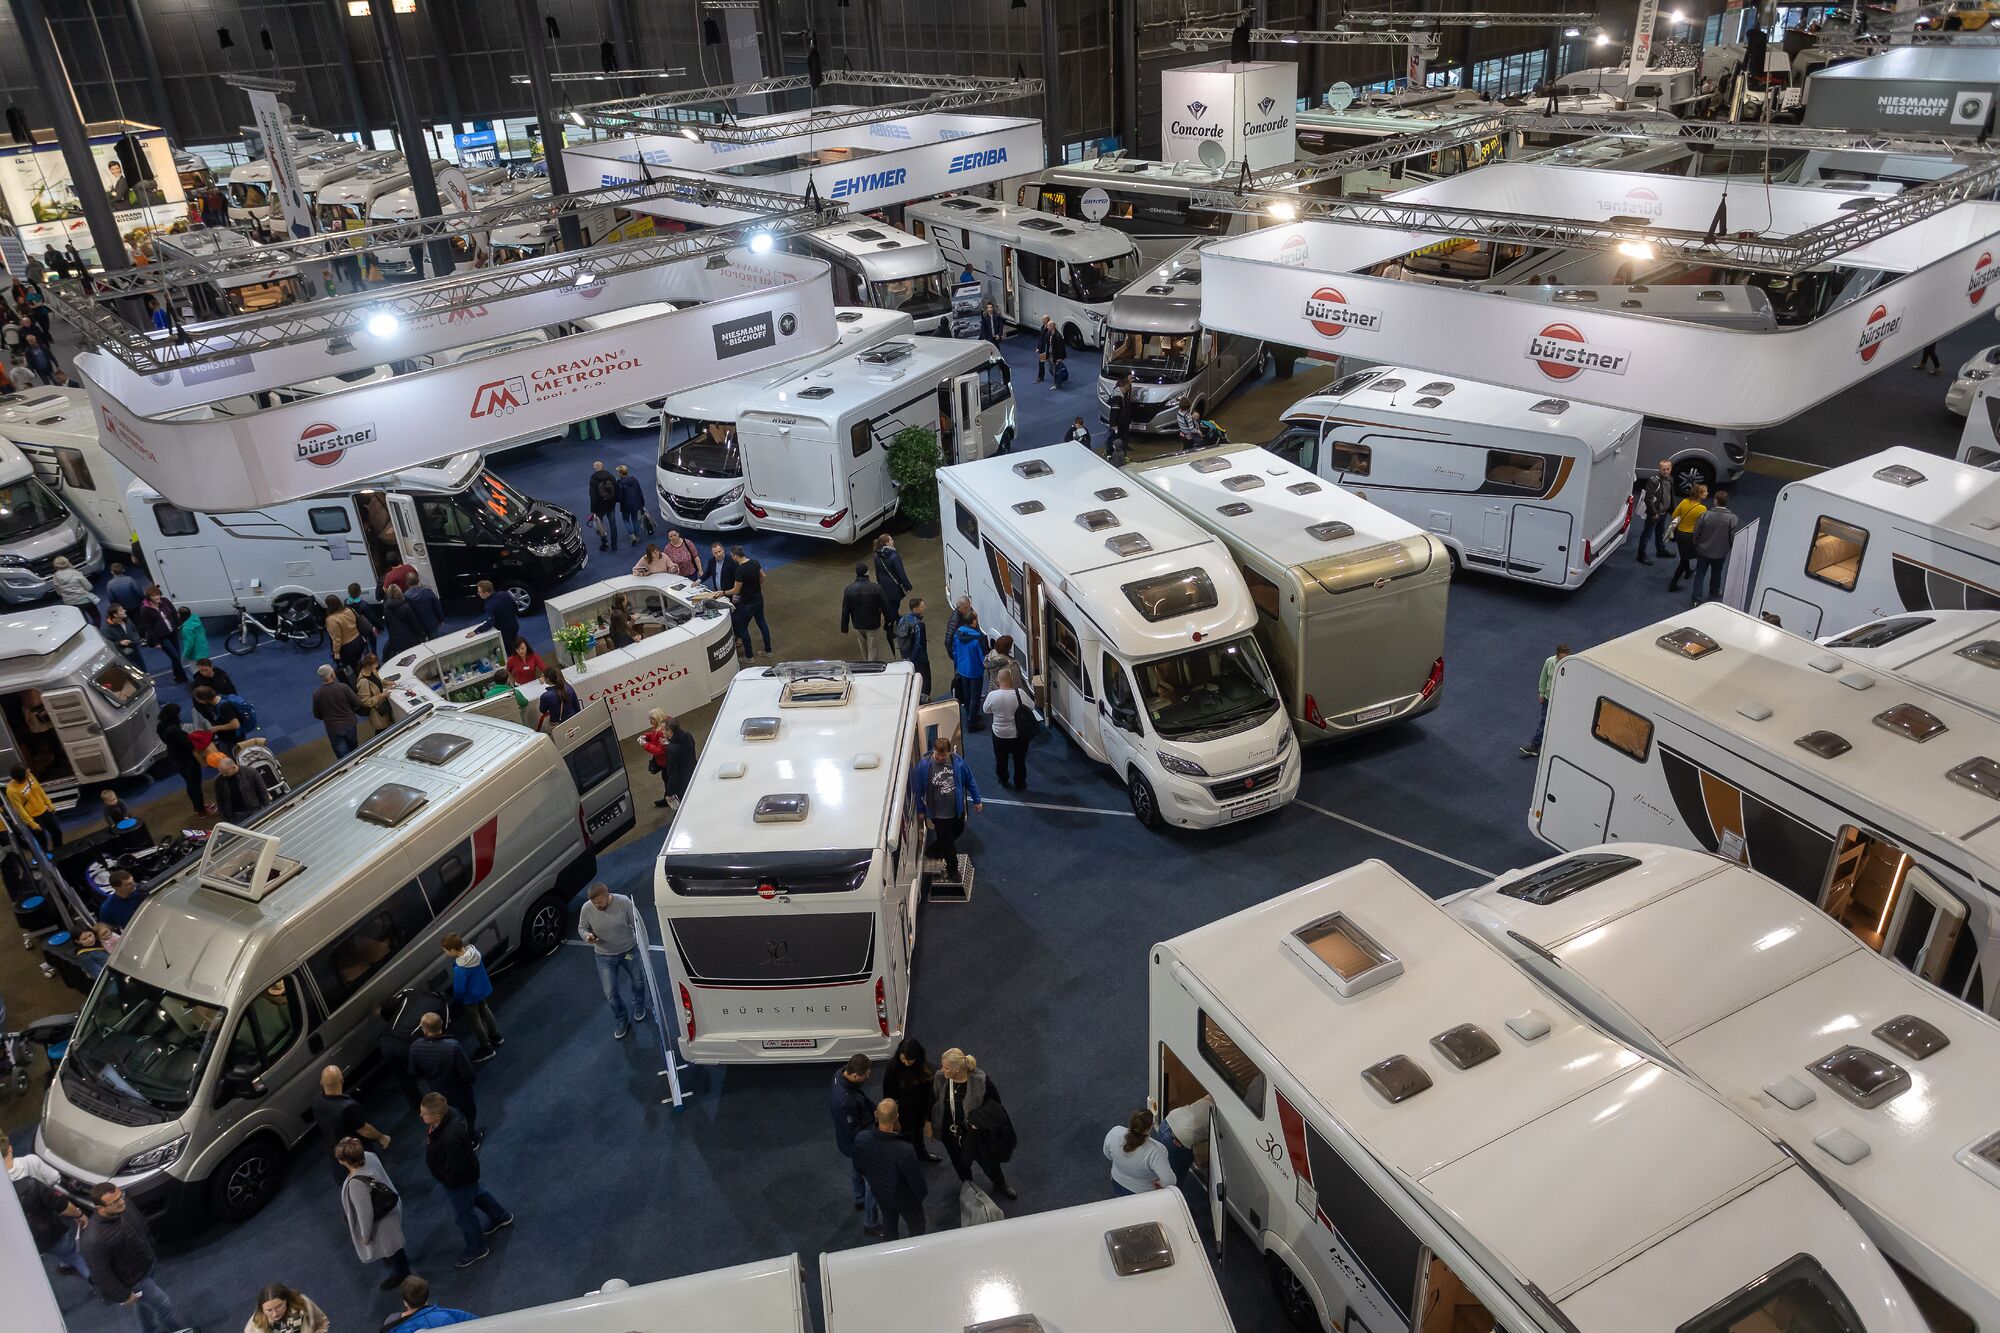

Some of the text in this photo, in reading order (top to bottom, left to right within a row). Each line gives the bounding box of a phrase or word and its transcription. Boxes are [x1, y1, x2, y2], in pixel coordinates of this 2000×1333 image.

[1635, 0, 1653, 61] FRANKIA
[1877, 96, 1949, 107] NIESMANN
[1171, 121, 1224, 138] Concorde
[1243, 116, 1288, 137] Concorde
[962, 147, 1008, 171] ERIBA
[847, 168, 907, 195] HYMER
[1305, 300, 1378, 327] bürstner
[721, 323, 767, 342] NIESMANN
[1858, 315, 1901, 348] bürstner
[1529, 338, 1624, 370] bürstner
[534, 357, 644, 394] METROPOL
[297, 428, 372, 459] bürstner
[608, 667, 691, 706] ETROPOL
[1256, 1132, 1283, 1162] 30
